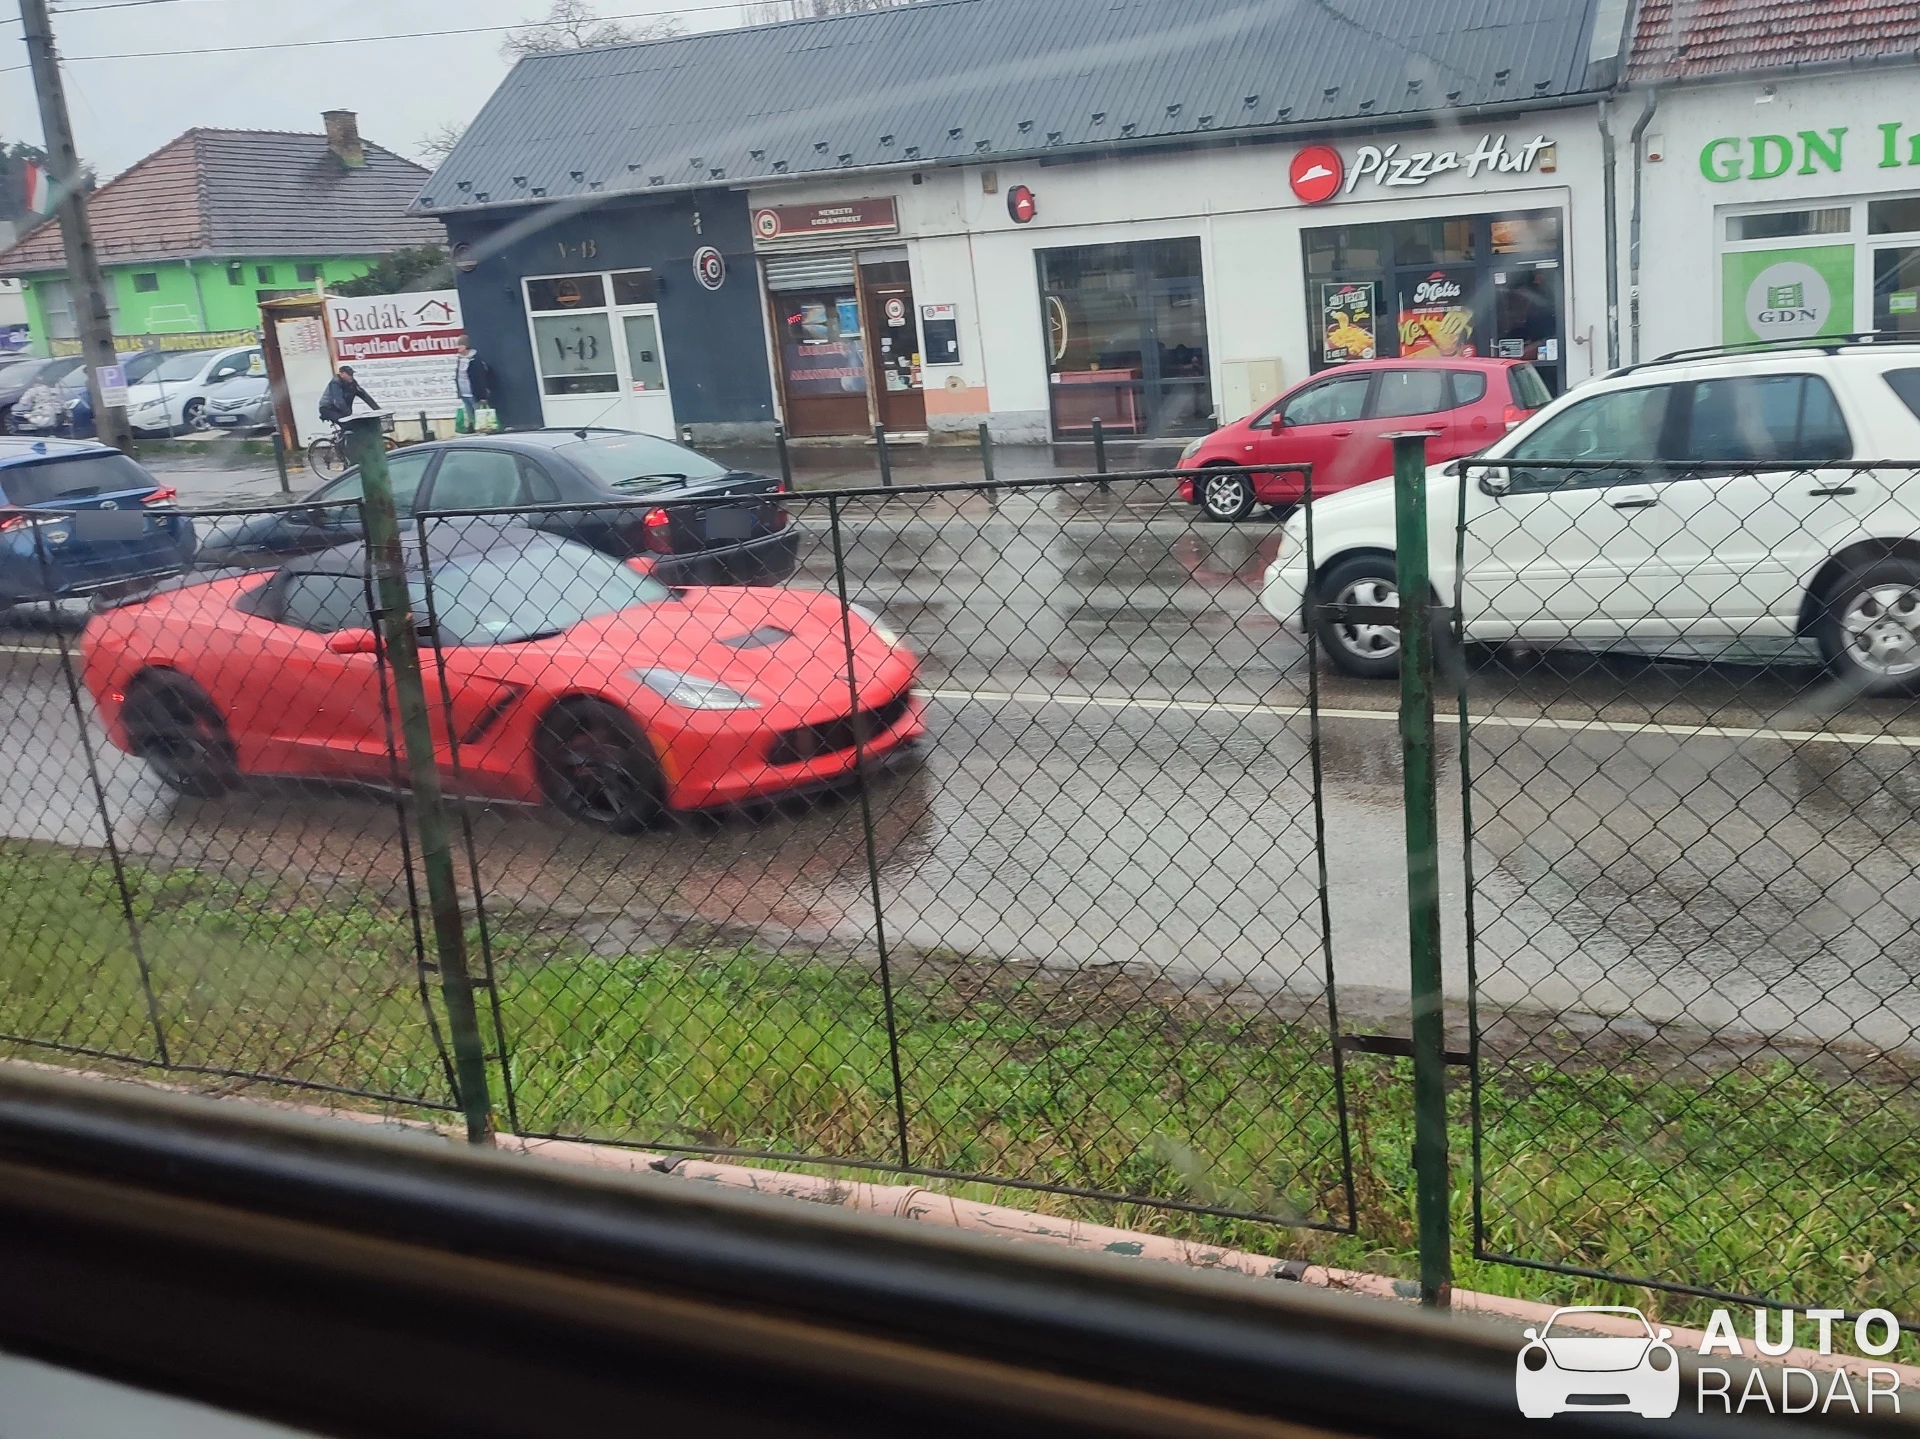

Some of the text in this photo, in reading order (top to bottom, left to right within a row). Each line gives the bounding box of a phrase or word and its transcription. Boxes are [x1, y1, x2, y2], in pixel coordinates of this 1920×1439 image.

[1345, 133, 1557, 193] Pizza Hut
[1700, 127, 1848, 183] GDN
[762, 219, 773, 230] 18
[1413, 281, 1461, 303] Melts
[333, 304, 409, 333] Radák
[1758, 308, 1817, 323] GDN
[103, 368, 118, 386] P
